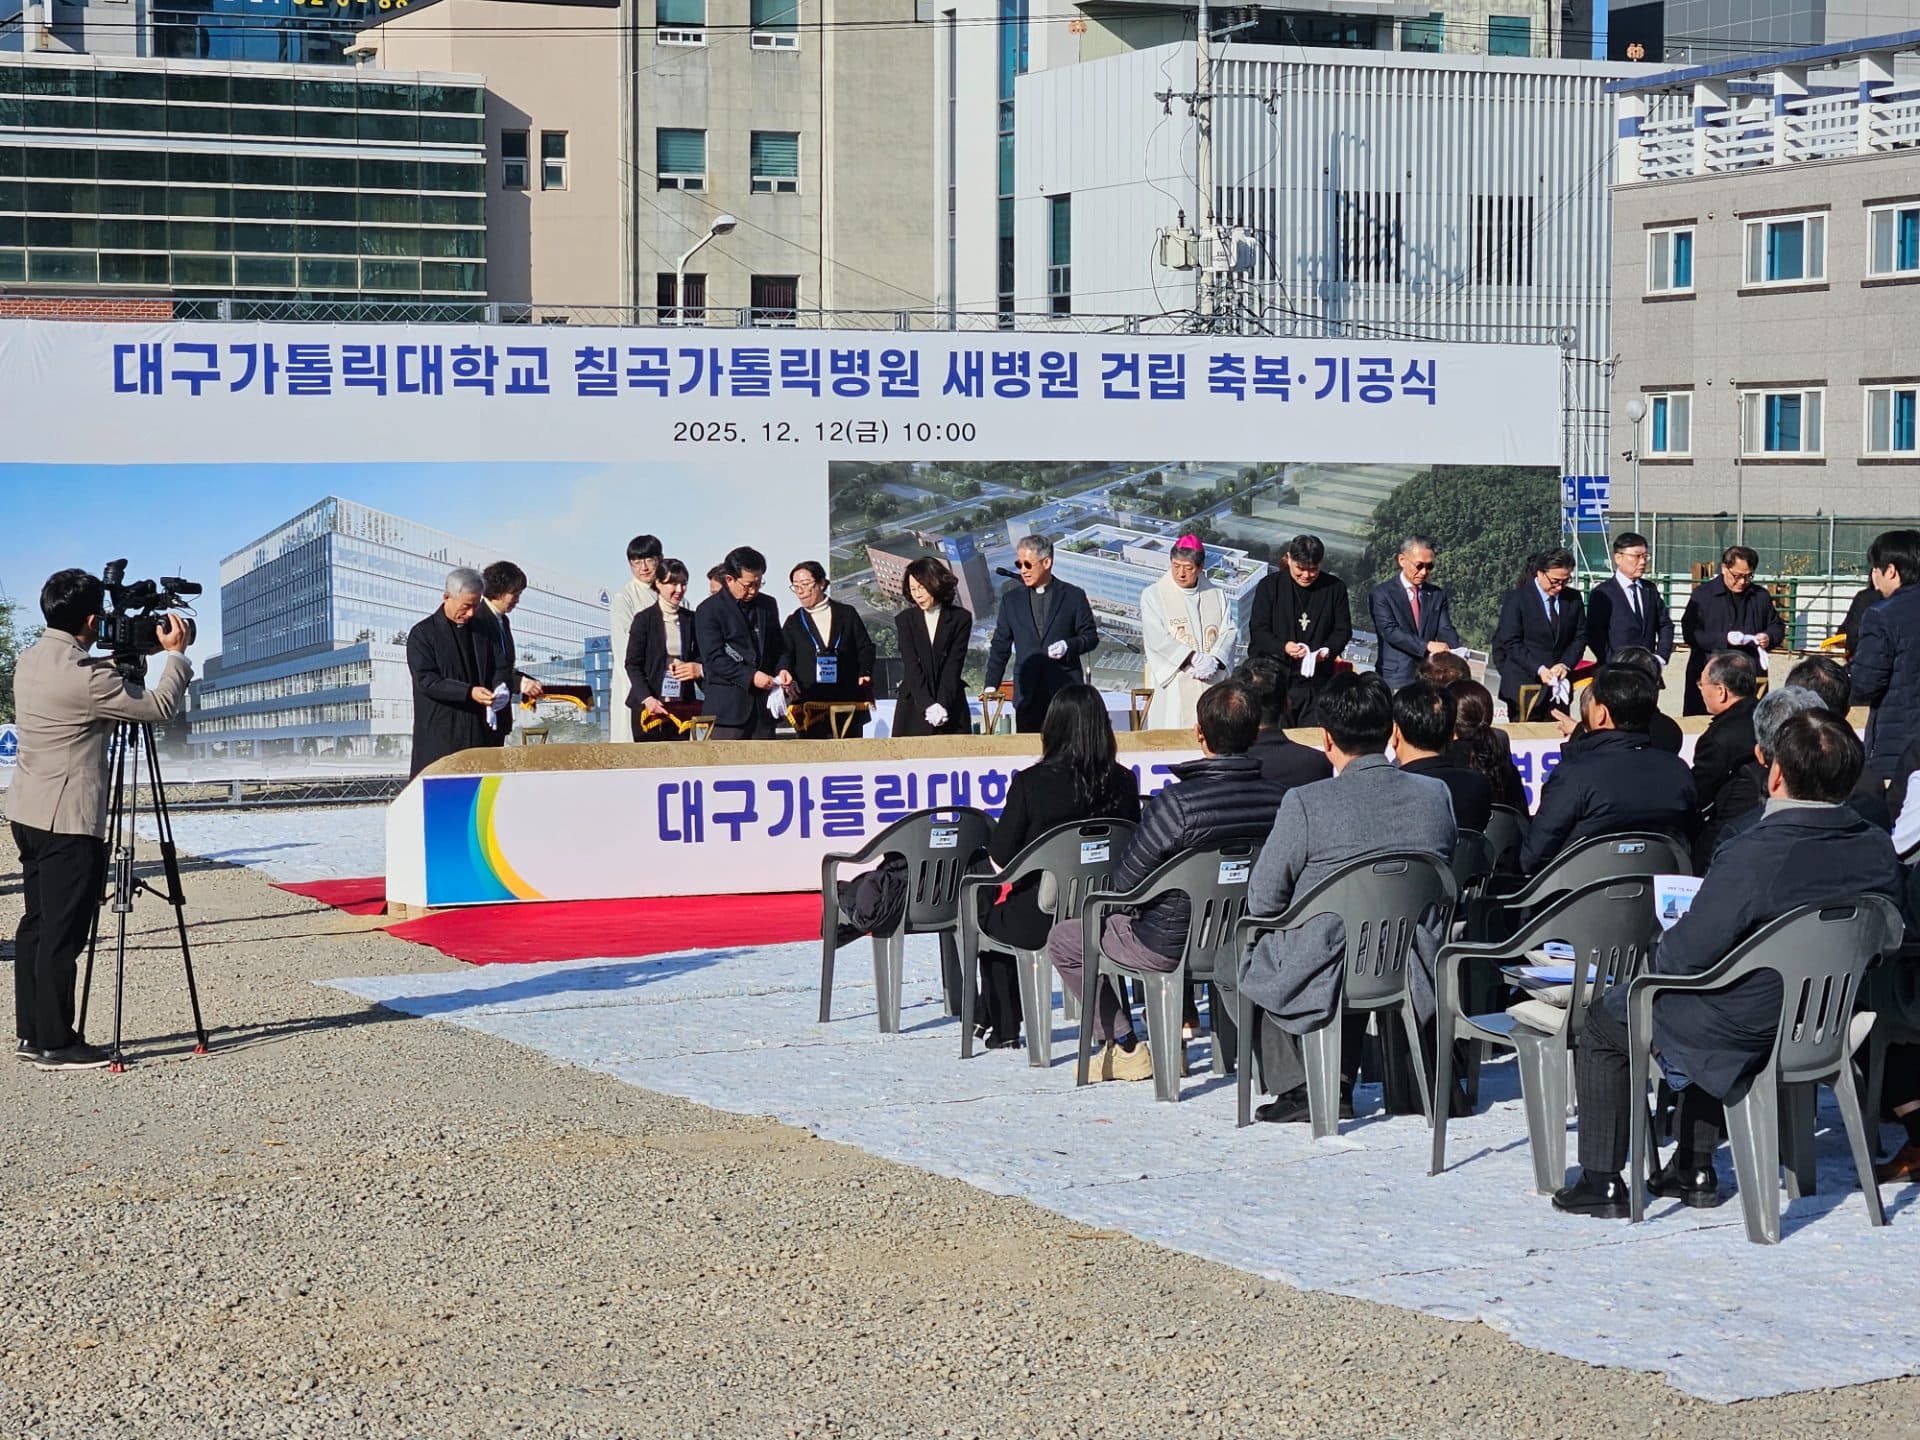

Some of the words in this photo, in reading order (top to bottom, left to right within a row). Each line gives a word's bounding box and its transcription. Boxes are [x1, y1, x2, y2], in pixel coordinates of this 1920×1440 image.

[113, 342, 551, 397] 대구가톨릭대학교
[575, 345, 921, 399] 칠곡가톨릭병원
[942, 350, 1079, 400] 새병원
[1101, 352, 1186, 401] 건립
[1207, 353, 1437, 406] 축복·기공식
[673, 421, 747, 443] 2025.
[762, 422, 799, 443] 12.
[815, 419, 889, 444] 12(금)
[903, 422, 976, 442] 10:00
[658, 769, 1018, 841] 대구가톨릭대학
